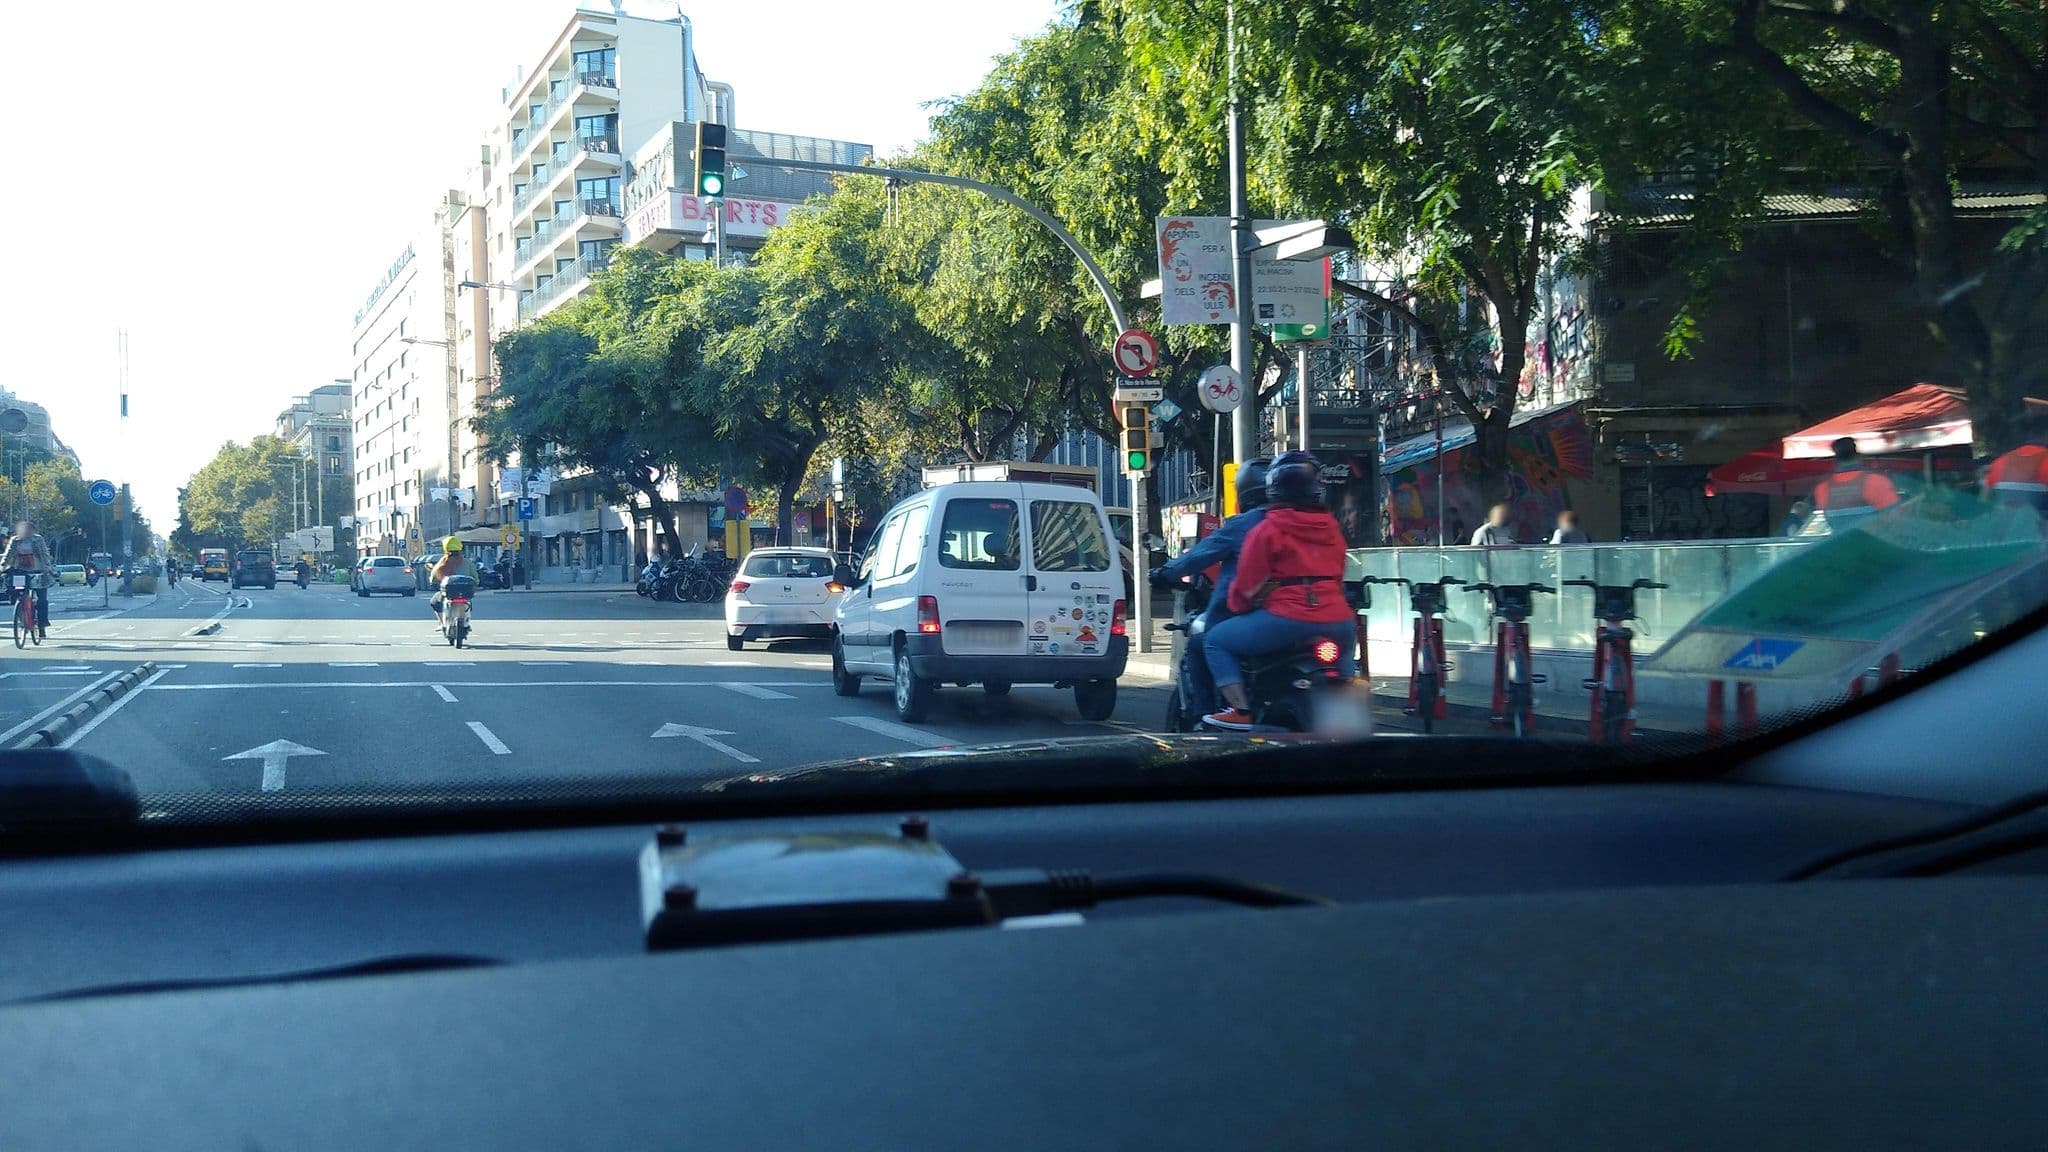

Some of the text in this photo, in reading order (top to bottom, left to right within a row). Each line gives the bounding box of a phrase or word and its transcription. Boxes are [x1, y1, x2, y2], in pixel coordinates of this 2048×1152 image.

[682, 195, 777, 225] BARTS
[1167, 230, 1201, 239] APUNTS
[1176, 259, 1189, 267] UN
[1174, 287, 1196, 296] DELS
[1203, 301, 1225, 310] ULLS
[520, 499, 531, 512] P
